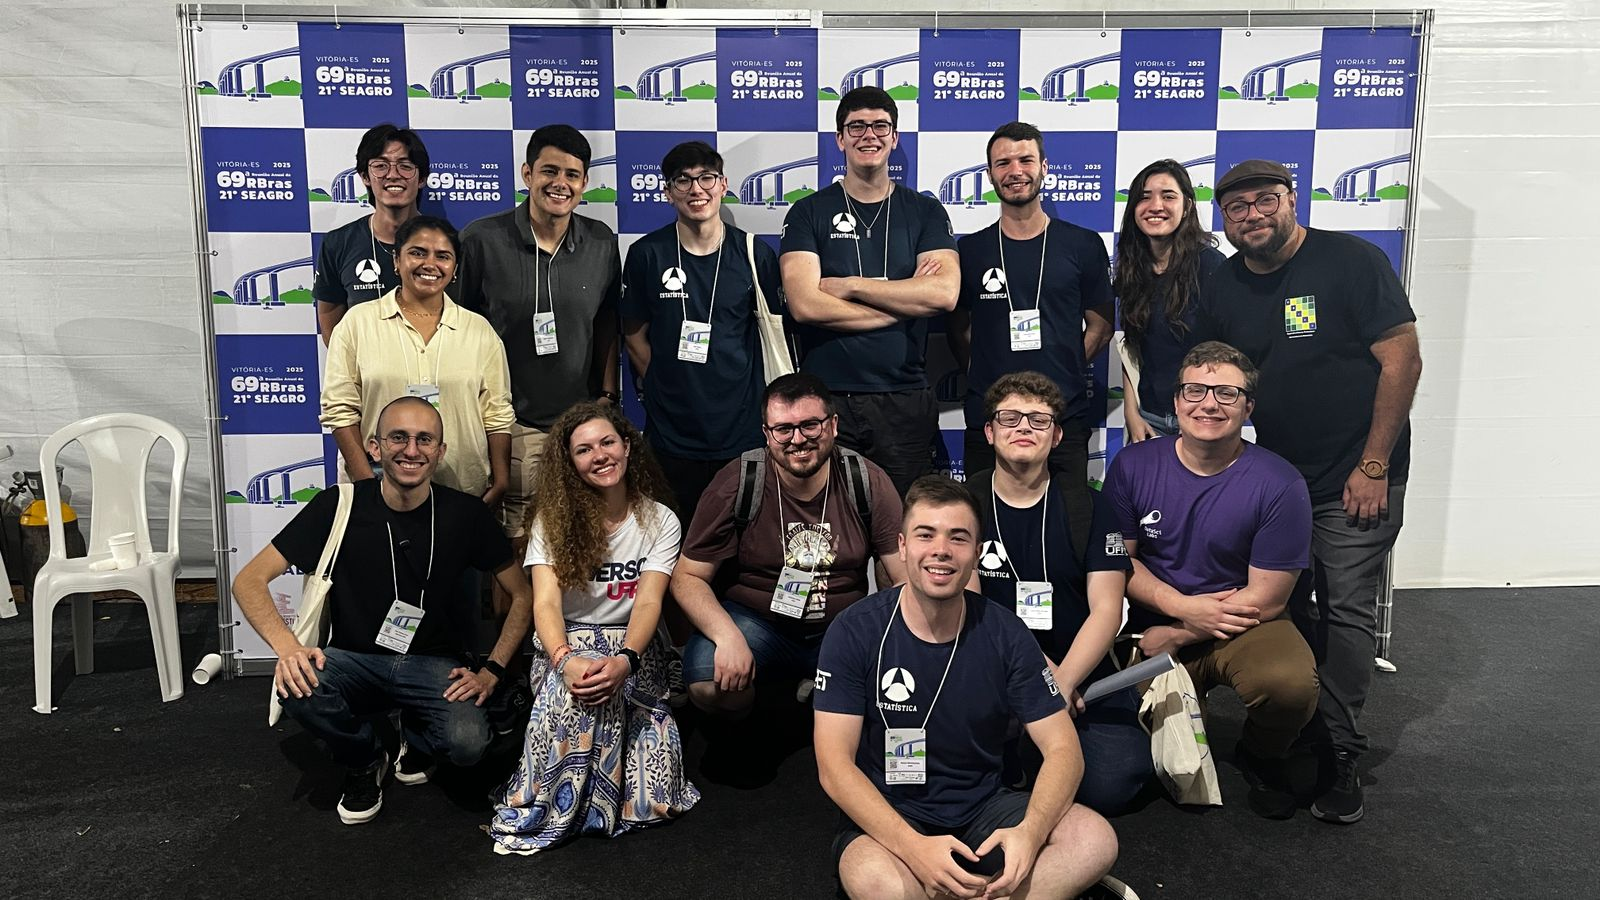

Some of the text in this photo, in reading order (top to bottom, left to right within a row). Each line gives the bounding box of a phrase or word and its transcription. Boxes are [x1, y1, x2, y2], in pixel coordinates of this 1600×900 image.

[316, 66, 348, 82] 69ª
[346, 73, 391, 84] RBras
[526, 69, 557, 85] 69ª
[731, 70, 762, 86] 69ª
[933, 71, 964, 87] 69ª
[1134, 71, 1165, 86] 69ª
[1334, 69, 1365, 85] 69ª
[554, 76, 598, 86] RBras
[759, 77, 802, 87] RBras
[961, 78, 1004, 87] RBras
[1161, 77, 1204, 87] RBras
[1361, 75, 1403, 85] RBras
[340, 86, 392, 96] SEAGRO
[548, 89, 600, 97] SEAGRO
[753, 90, 803, 99] SEAGRO
[955, 90, 1005, 99] SEAGRO
[1155, 90, 1204, 98] SEAGRO
[1354, 88, 1403, 96] SEAGRO
[217, 171, 250, 187] 69ª
[247, 178, 292, 188] RBras
[427, 173, 458, 188] 69ª
[455, 179, 499, 189] RBras
[631, 174, 662, 190] 69ª
[1058, 180, 1100, 190] RBras
[241, 191, 294, 200] SEAGRO
[449, 192, 500, 200] SEAGRO
[1052, 193, 1101, 201] SEAGRO
[232, 376, 263, 392] 69ª
[261, 383, 304, 392] RBras
[255, 395, 306, 403] SEAGRO
